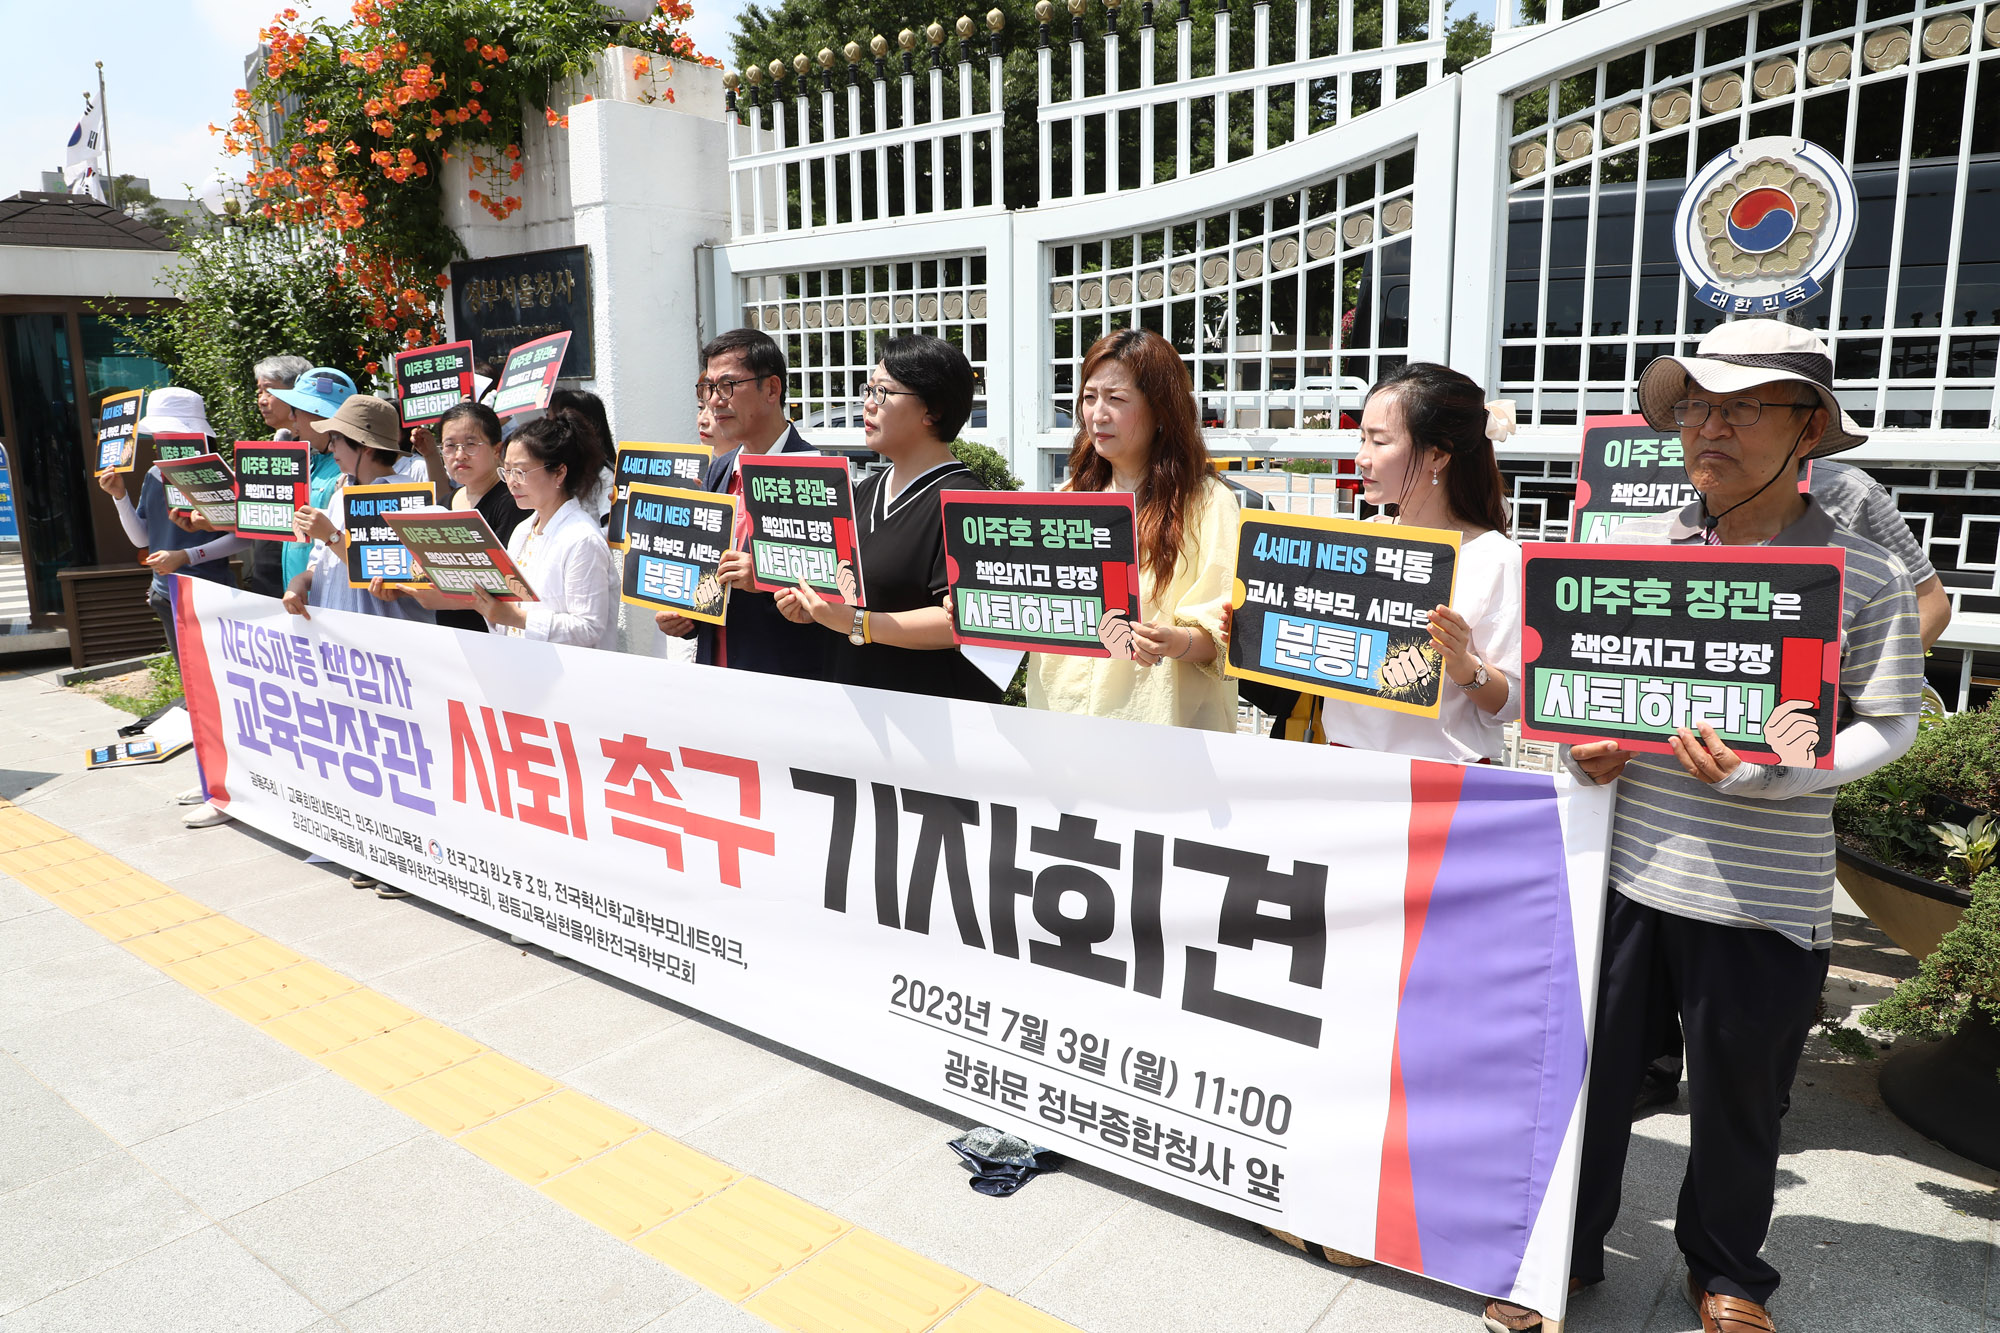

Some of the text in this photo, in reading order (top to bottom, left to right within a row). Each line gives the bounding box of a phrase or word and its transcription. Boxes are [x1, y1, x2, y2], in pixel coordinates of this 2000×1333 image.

[466, 269, 575, 313] 정부서울청사
[1709, 286, 1806, 312] 대한민국
[404, 354, 464, 377] 이주호 장관은
[410, 376, 459, 395] 책임지고 당장
[406, 392, 459, 418] 사퇴하라!
[102, 441, 121, 465] 분통!
[241, 456, 299, 476] 이주호 장관은
[622, 455, 700, 479] 4세대 NEIS 먹통
[1603, 437, 1685, 468] 이주호
[245, 483, 294, 501] 책임지고 당장
[752, 476, 838, 507] 이주호 장관은
[1610, 482, 1700, 507] 책임지고
[239, 503, 293, 529] 사퇴하라!
[350, 499, 375, 517] 4세대
[376, 499, 399, 516] NEIS
[634, 499, 723, 533] 4세대 NEIS 먹통
[350, 527, 369, 542] 교사,
[402, 526, 485, 544] 이주호 장관은
[761, 515, 833, 543] 책임지고 당장
[962, 516, 1112, 550] 이주호 장관은
[365, 547, 408, 576] 분통!
[424, 551, 492, 566] 책임지고 당장
[630, 532, 721, 564] 교사, 학부모, 시민은
[758, 543, 836, 584] 사퇴하라!
[1252, 532, 1434, 585] 4세대 NEIS 먹통
[431, 568, 508, 590] 사퇴하라!
[643, 559, 693, 600] 분통!
[975, 560, 1099, 591] 책임지고 당장
[964, 591, 1098, 637] 사퇴하라!
[1246, 578, 1431, 630] 교사, 학부모, 시민은
[1555, 575, 1802, 622] 이주호 장관은
[217, 616, 413, 710] NEIS파동 책임자
[1274, 618, 1373, 681] 분통!
[1571, 632, 1774, 675] 책임지고 당장
[1541, 673, 1764, 736] 사퇴하라!
[226, 670, 437, 817] 교육부장관
[287, 786, 355, 830] 교육희망네트워크,
[555, 881, 748, 970] 전국혁신학교학부모네트워크,
[447, 698, 1329, 1049] 사퇴 촉구 기자회견
[291, 811, 696, 986] 징검다리교육공동체, 참교육을위한전국학부모회, 평등교육실현을위한전국학부모회
[890, 973, 1292, 1136] 2023년 7월 3일 (월) 11:00
[944, 1049, 1285, 1203] 광화문 정부종합청사 앞
